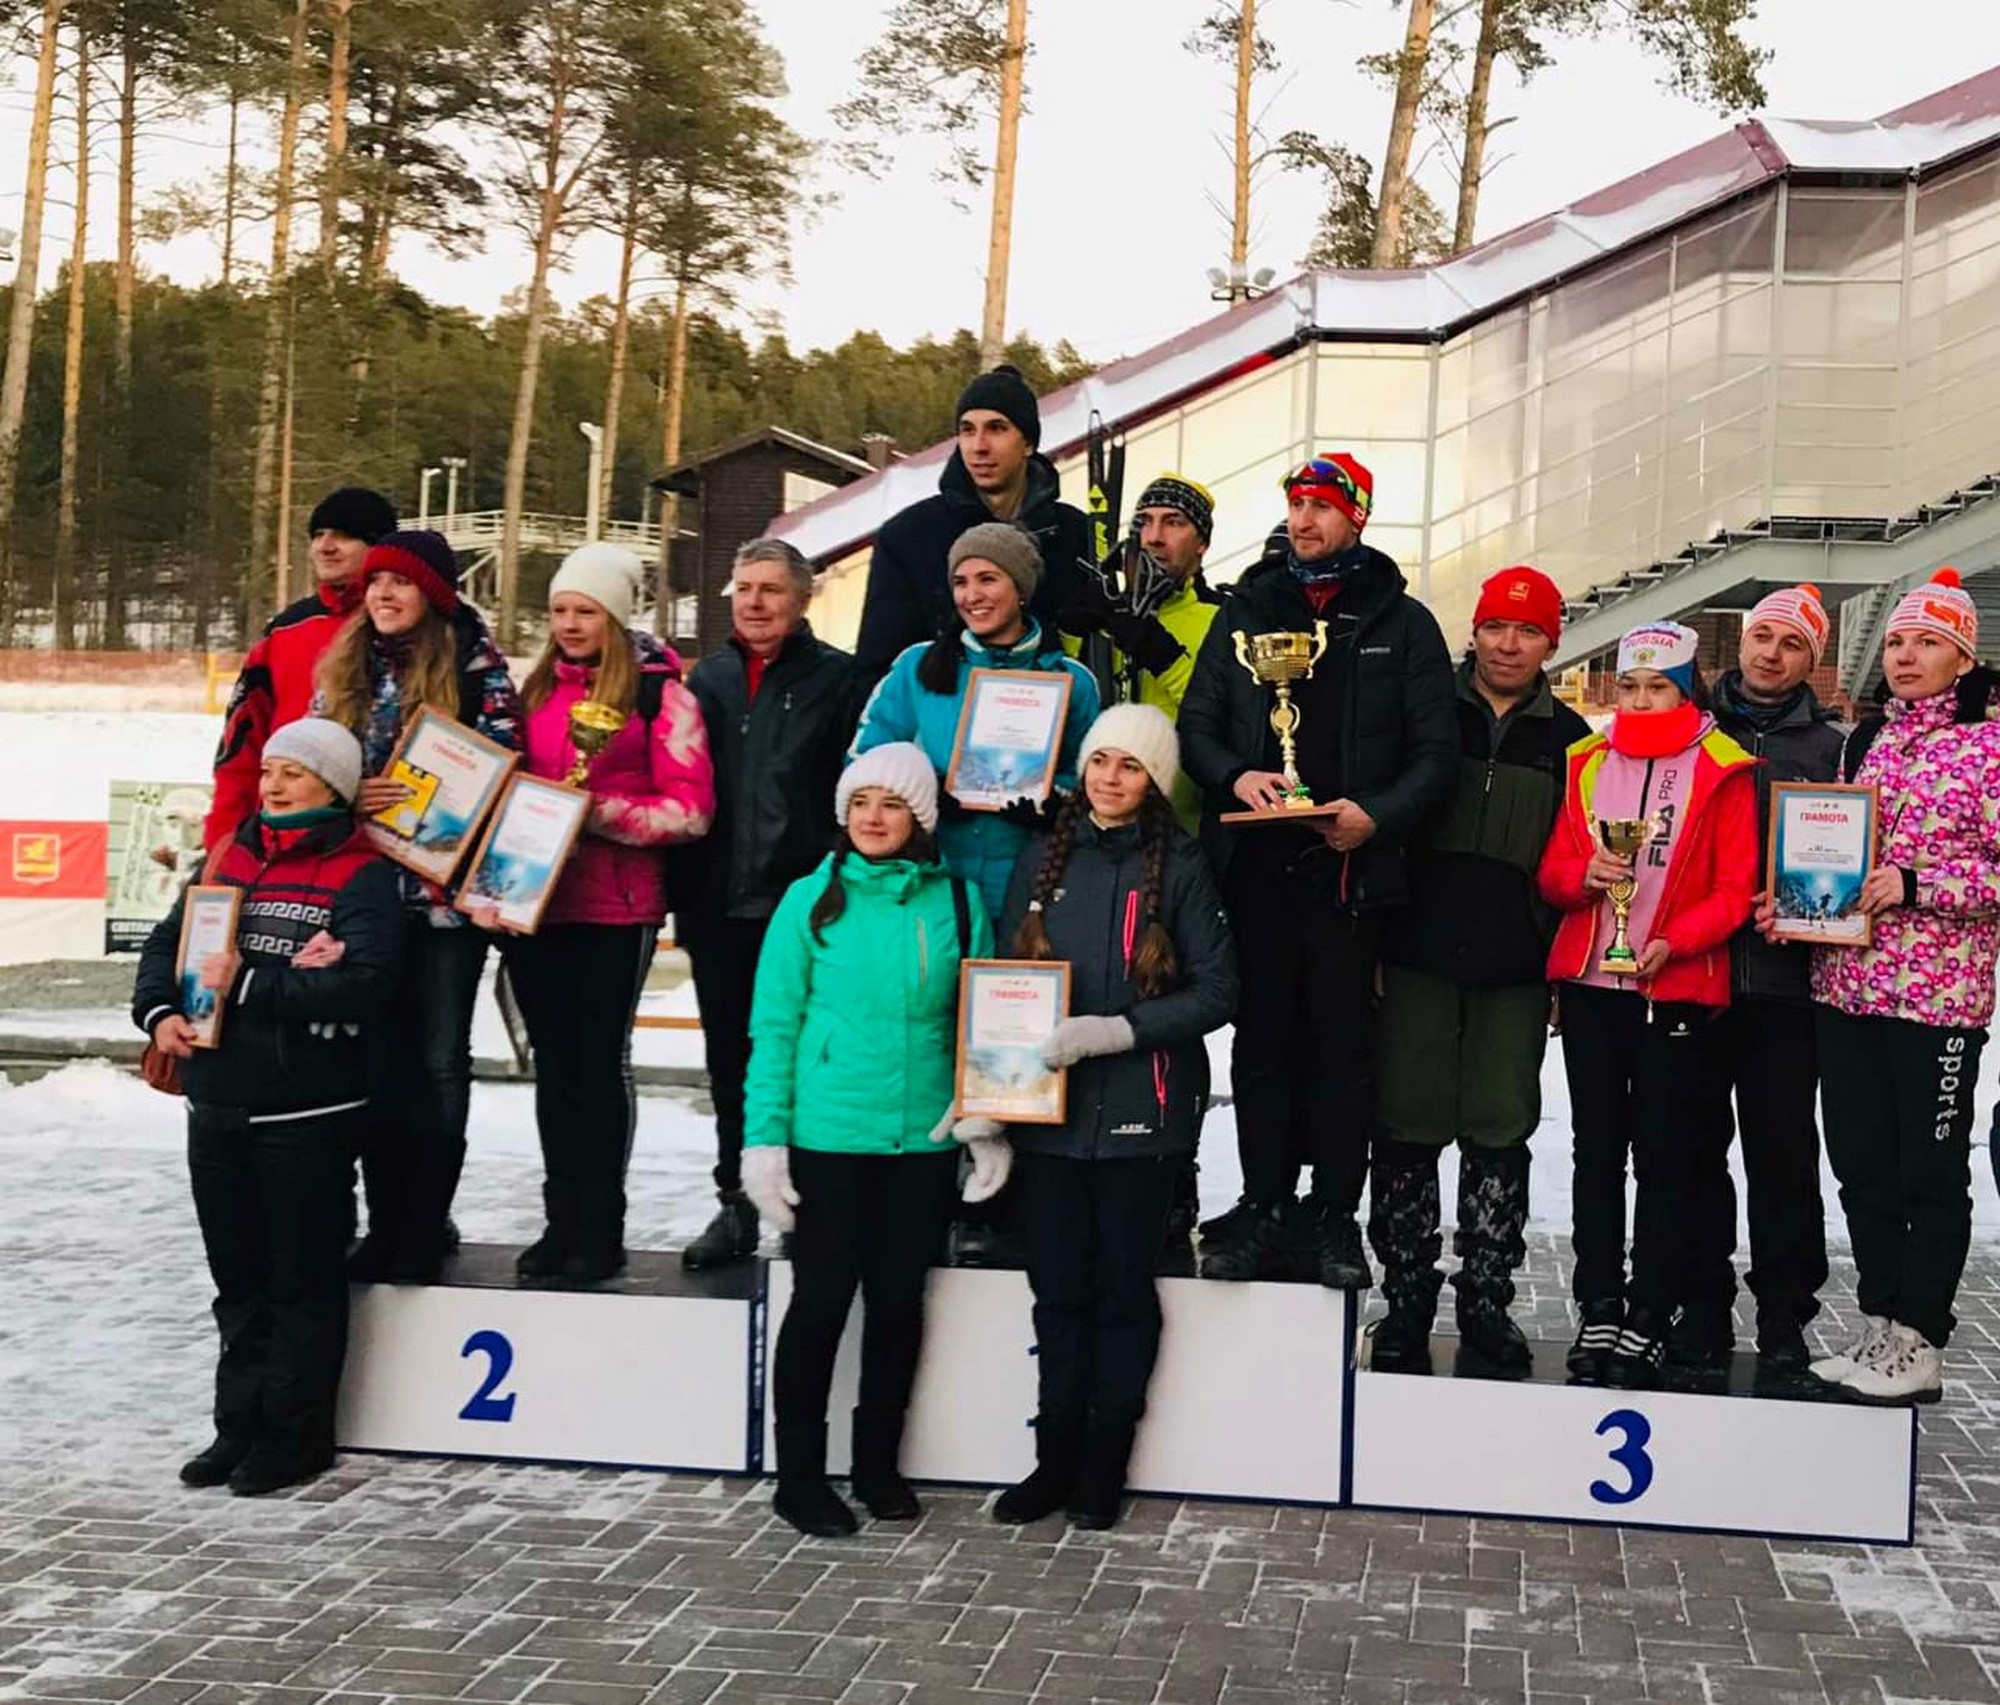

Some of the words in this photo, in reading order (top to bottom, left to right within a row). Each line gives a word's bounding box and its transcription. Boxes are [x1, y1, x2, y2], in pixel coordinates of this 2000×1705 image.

[1657, 769, 1679, 801] PRO
[1800, 811, 1849, 824] ГРАМОТА
[1647, 803, 1676, 868] FILA
[1935, 1036, 1966, 1141] sports
[459, 1329, 517, 1423] 2
[1590, 1408, 1654, 1504] 3
